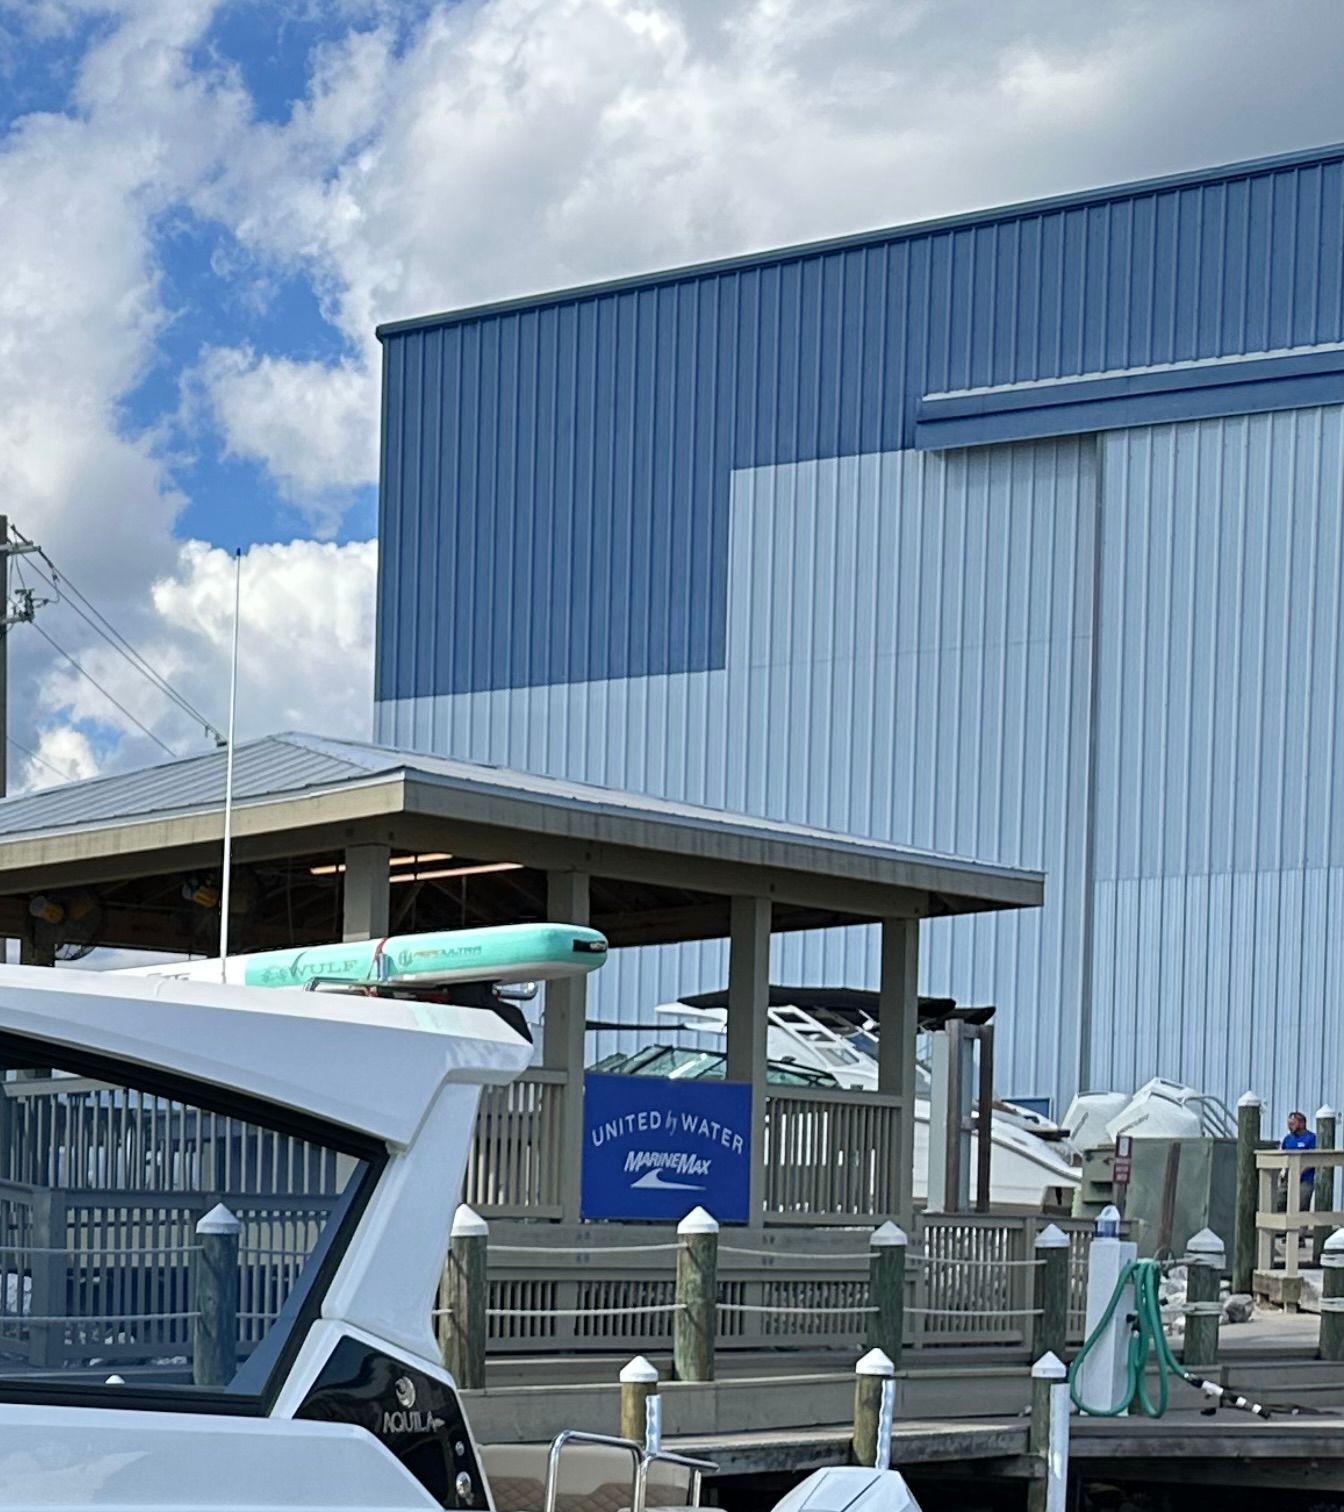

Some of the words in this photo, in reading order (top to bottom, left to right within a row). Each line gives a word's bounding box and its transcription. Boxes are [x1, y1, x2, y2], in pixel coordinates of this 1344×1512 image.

[591, 1110, 662, 1147] UNITED
[665, 1110, 677, 1136] by
[680, 1112, 744, 1155] WATER
[383, 1410, 438, 1434] AQUILA
